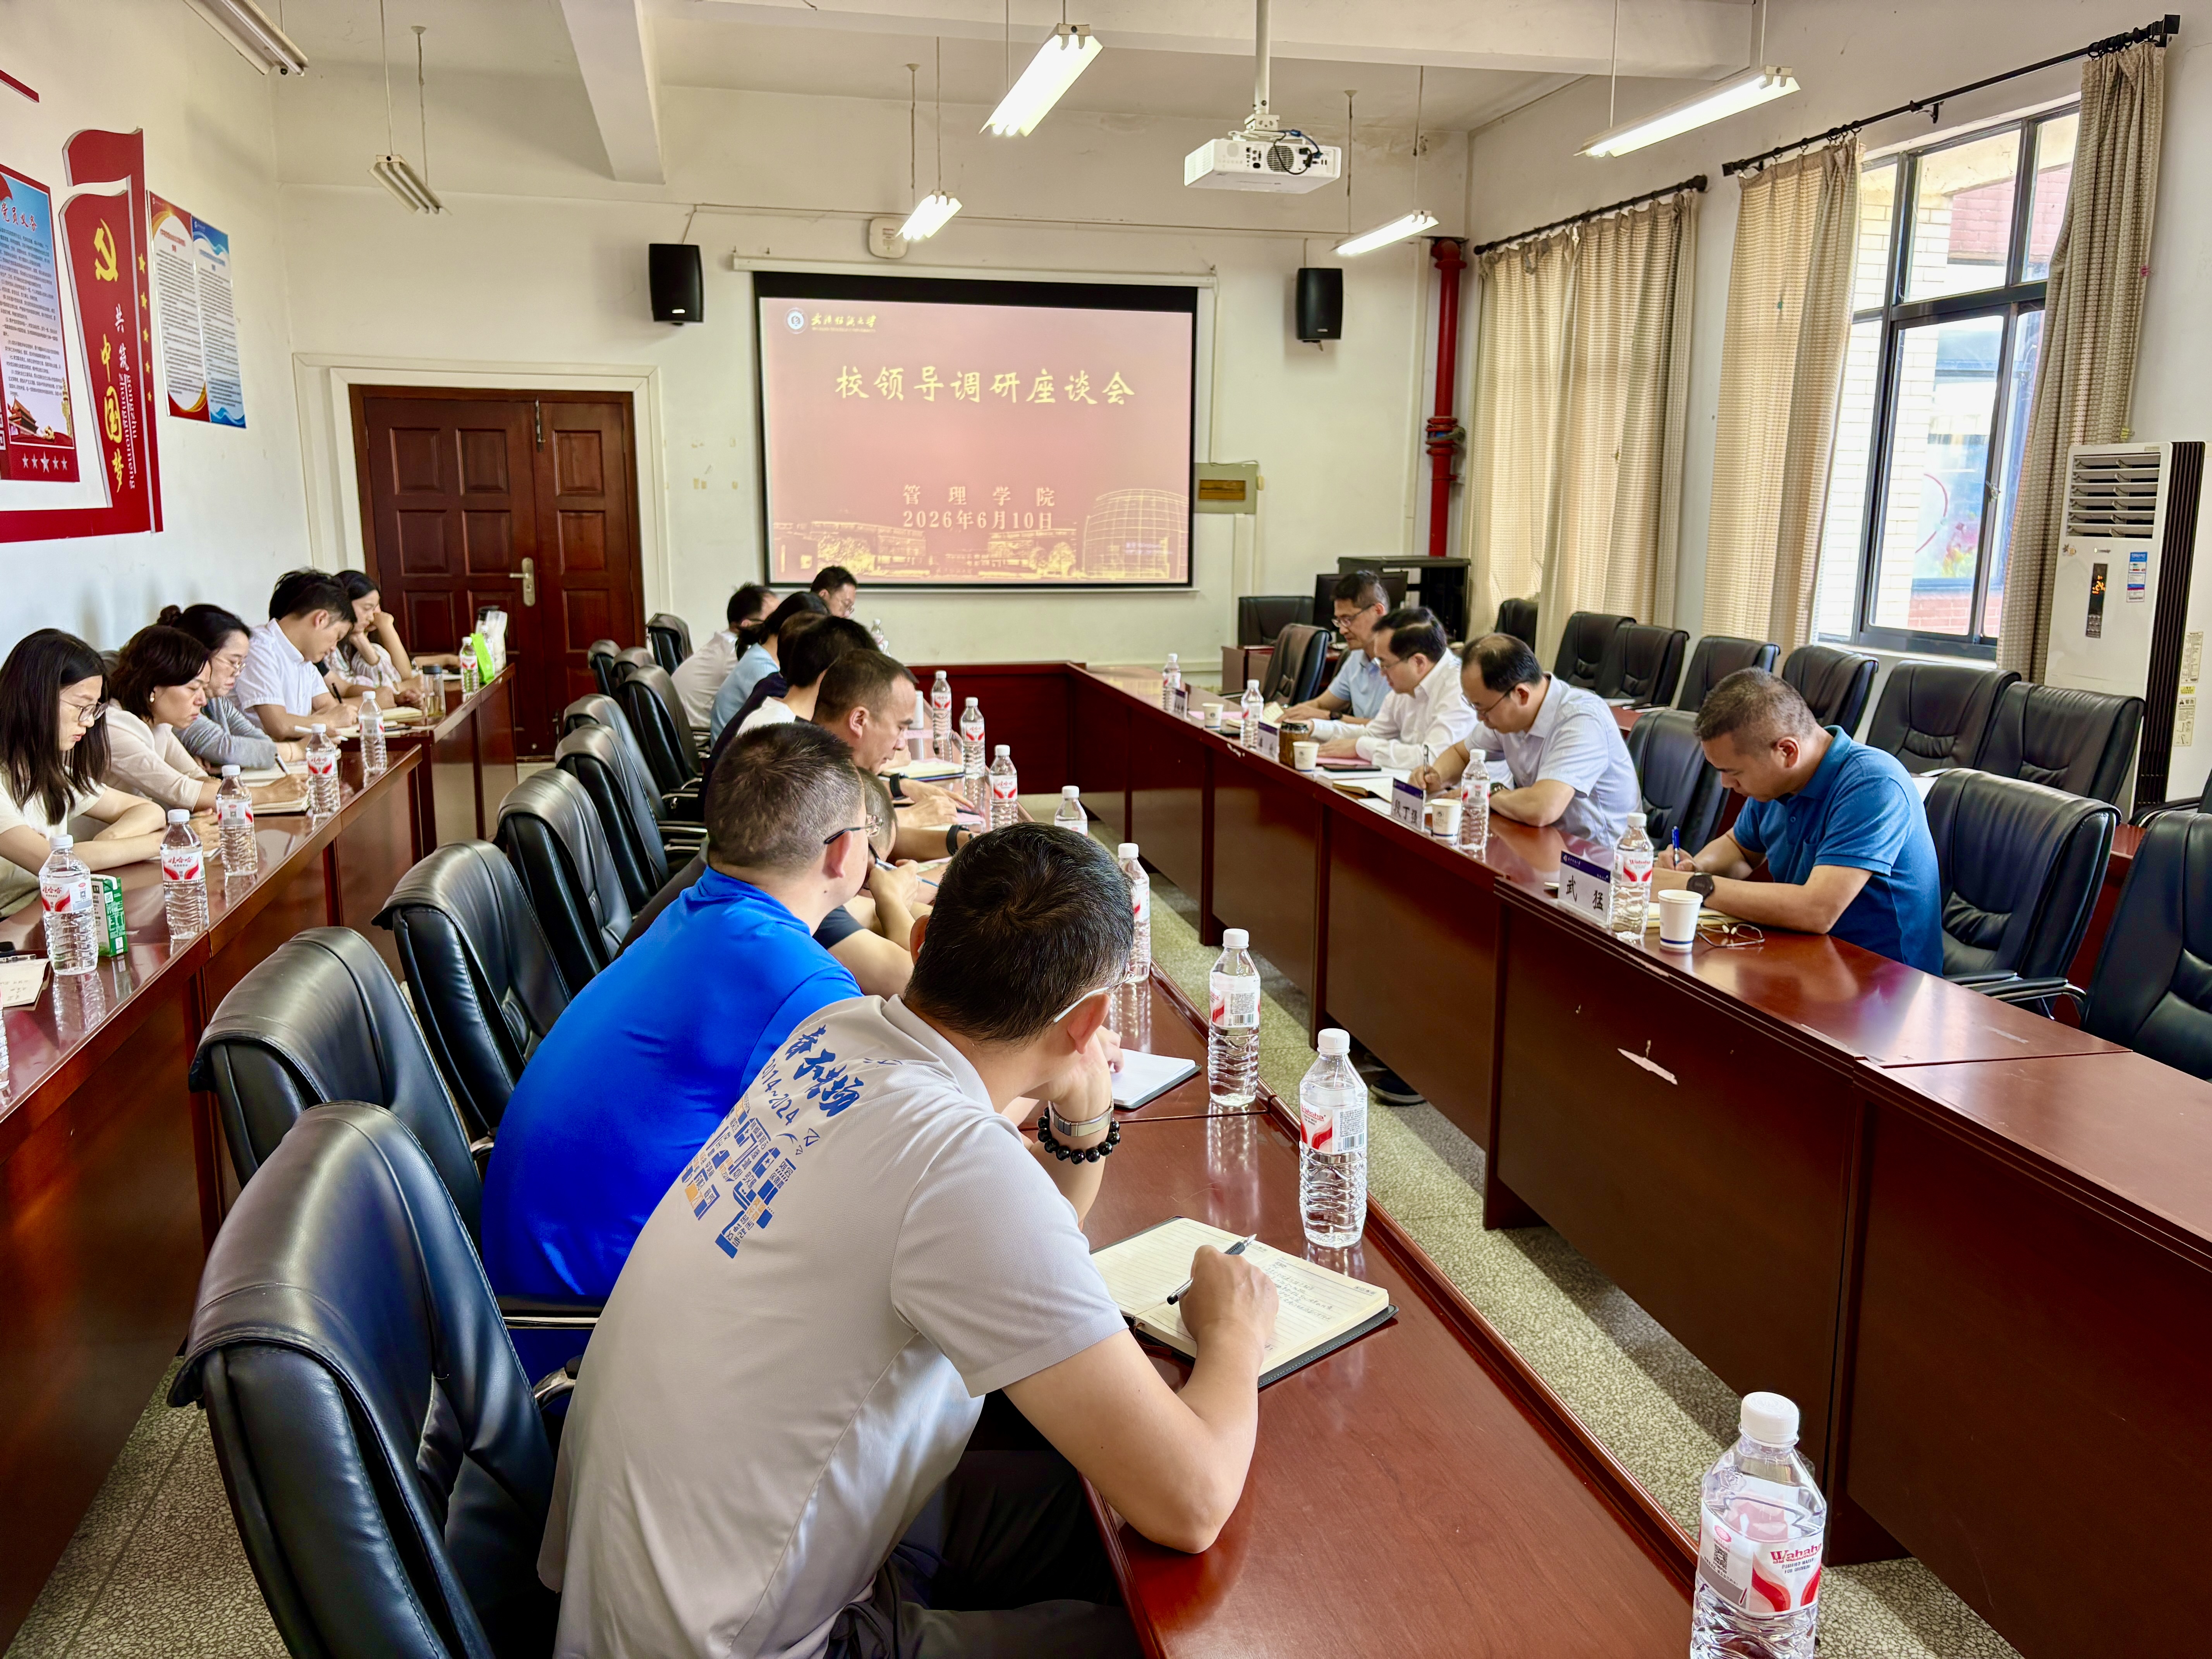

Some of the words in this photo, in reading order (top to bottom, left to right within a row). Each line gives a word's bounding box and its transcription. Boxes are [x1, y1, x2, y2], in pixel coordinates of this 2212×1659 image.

[115, 303, 130, 371] 共筑
[835, 365, 1135, 405] 校领导调研座谈会
[101, 333, 124, 493] 中国梦
[903, 484, 1055, 507] 管理学院
[903, 509, 1052, 530] 2026年6月10日
[1566, 874, 1604, 911] 武猛
